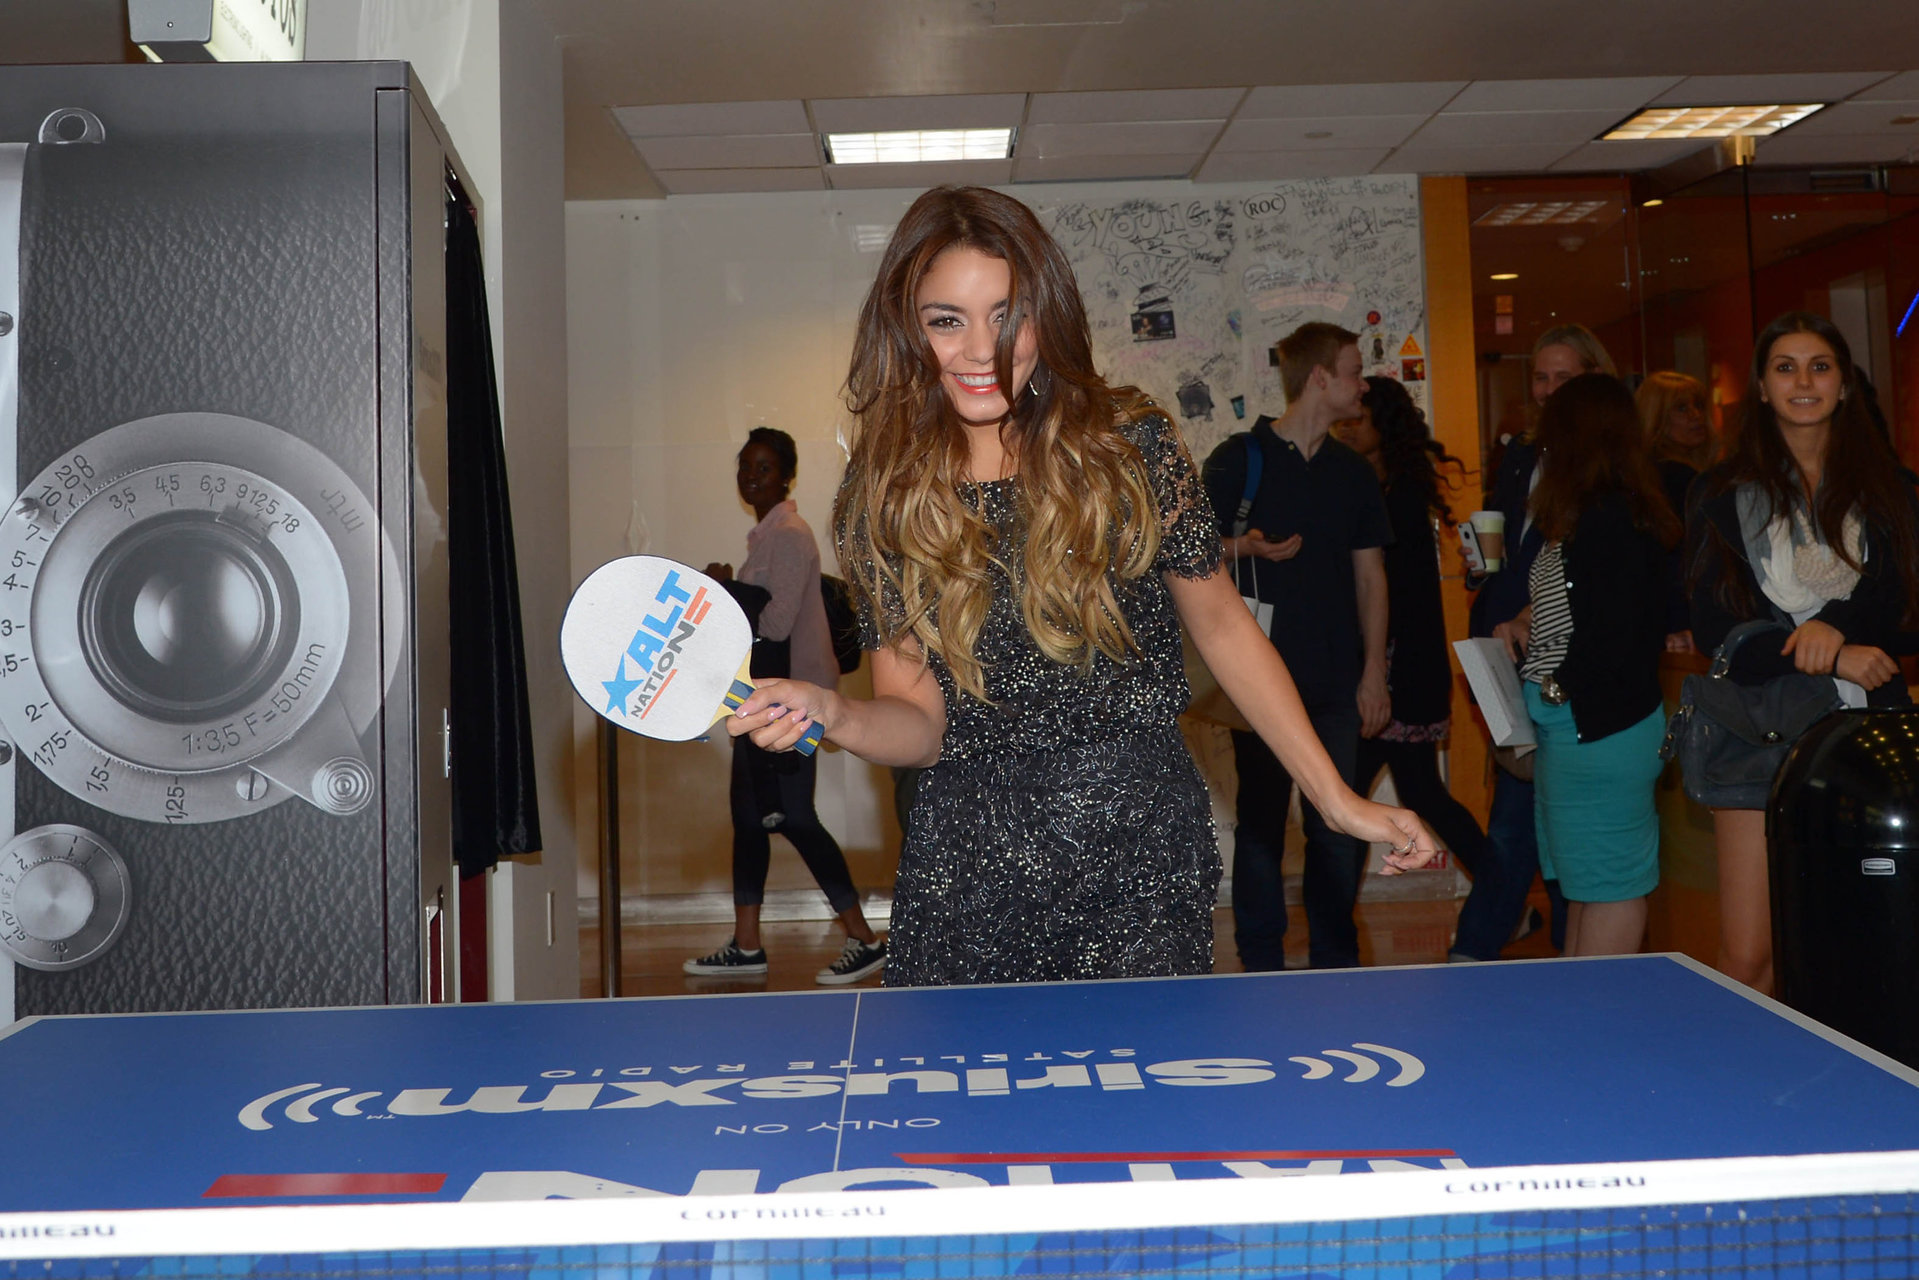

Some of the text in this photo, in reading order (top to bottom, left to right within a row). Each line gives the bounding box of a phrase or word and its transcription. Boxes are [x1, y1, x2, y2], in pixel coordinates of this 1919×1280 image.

[1249, 197, 1281, 216] ROC
[54, 465, 80, 490] 20
[155, 474, 180, 497] 4,5
[200, 475, 226, 495] 6,3
[39, 485, 62, 507] 10
[236, 484, 248, 499] 9
[25, 524, 41, 541] 7
[282, 513, 300, 533] 18
[11, 550, 27, 568] 5
[3, 573, 18, 591] 4
[1, 619, 12, 636] 3
[627, 569, 691, 674] ALT
[0, 654, 18, 677] ,5
[631, 620, 696, 718] NATION
[25, 704, 42, 722] 2
[33, 732, 67, 766] 1,75
[182, 723, 241, 754] 1:3,5
[86, 766, 110, 792] 1,5
[164, 786, 189, 824] 1,25
[540, 1048, 1136, 1079] SATELLITE RADIO
[714, 1117, 941, 1136] ONLY ON
